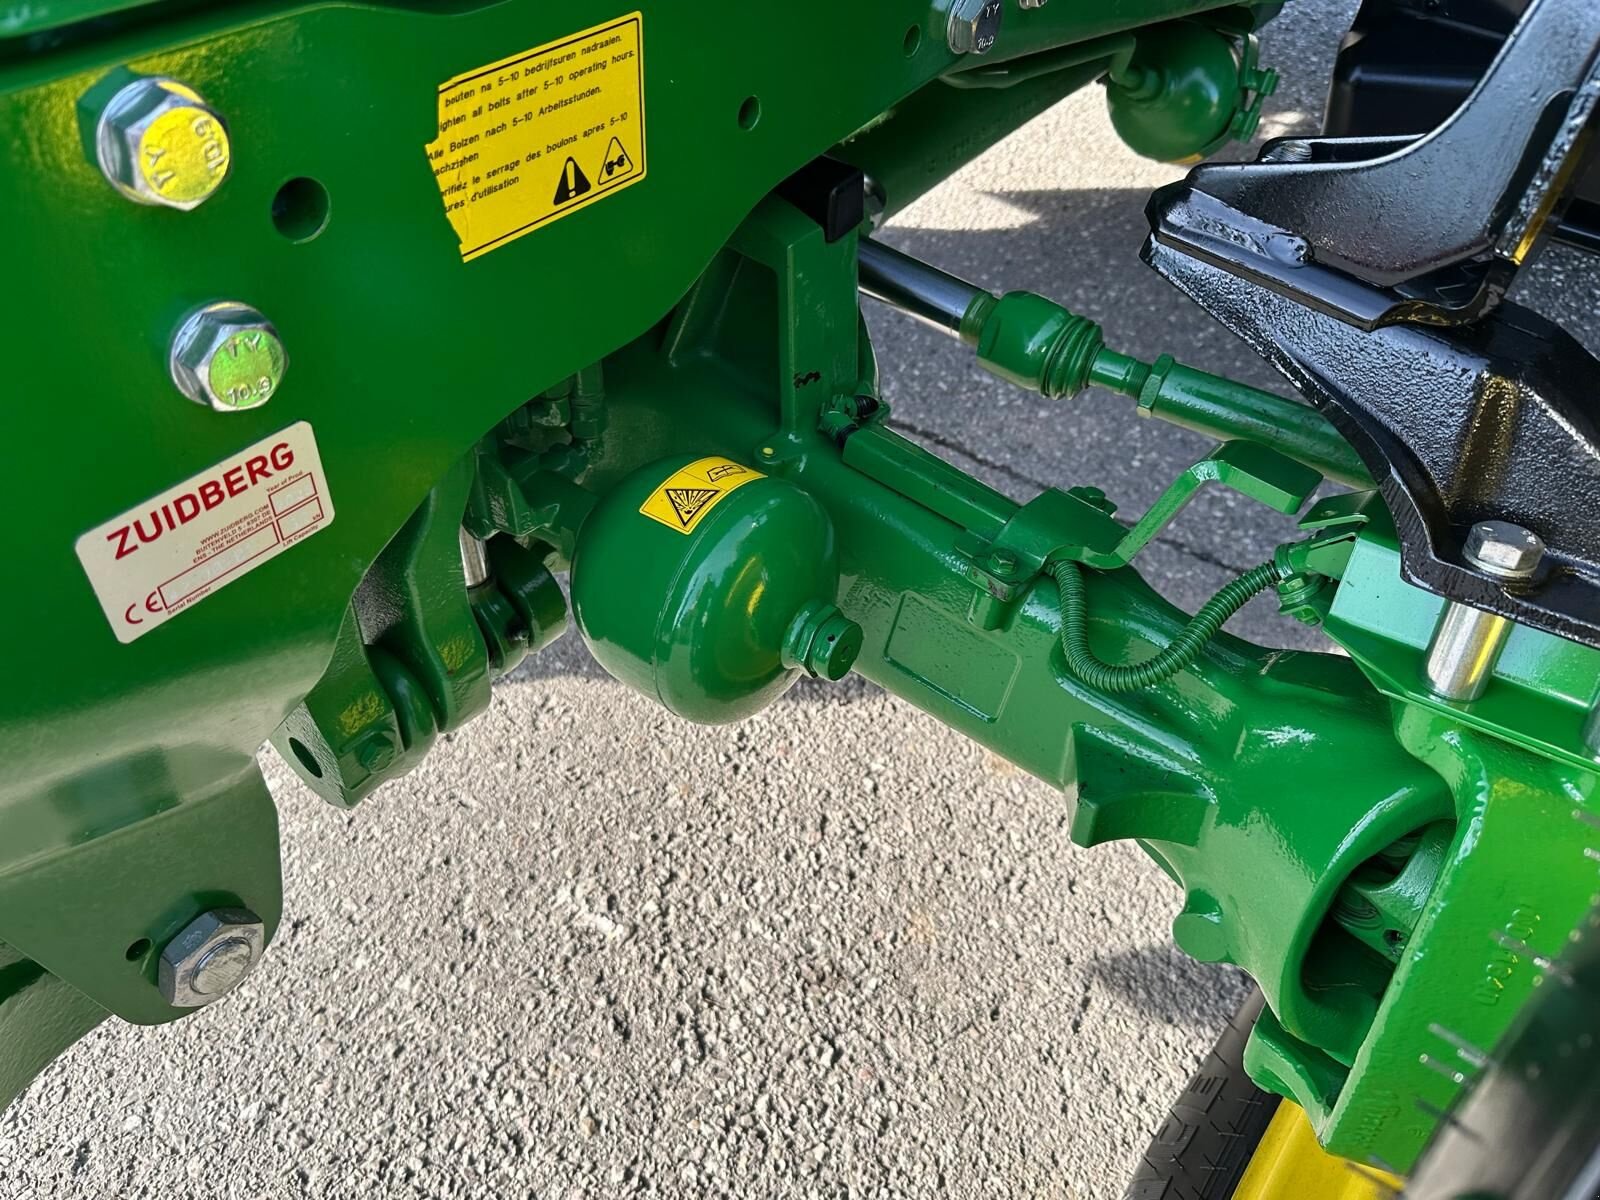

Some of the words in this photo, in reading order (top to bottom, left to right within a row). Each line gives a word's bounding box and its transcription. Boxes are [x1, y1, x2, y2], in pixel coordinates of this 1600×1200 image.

[445, 89, 475, 107] bouten
[481, 83, 492, 94] na
[498, 71, 519, 86] 5-10
[525, 51, 576, 77] bedrijfsuren
[581, 34, 622, 56] nadraaien.
[472, 108, 482, 118] all
[488, 96, 510, 111] bolts
[517, 87, 538, 101] after
[544, 75, 563, 90] 5-10
[569, 60, 607, 81] operating
[612, 50, 635, 63] hours.
[428, 149, 444, 161] Alle
[450, 135, 480, 152] Bolzen
[485, 123, 507, 137] nach
[512, 113, 532, 126] 5-10
[538, 86, 602, 116] Arbeitsstunden.
[473, 174, 480, 184] le
[486, 160, 520, 179] serrage
[526, 150, 541, 163] des
[547, 134, 577, 154] boulons
[583, 124, 605, 138] apres
[610, 112, 628, 126] 5-10
[471, 176, 519, 202] d'utilisation
[227, 376, 272, 406] 10.9
[107, 443, 294, 560] ZUIDBERG
[262, 510, 270, 518] DE
[193, 553, 207, 563] ENS
[212, 543, 225, 555] THE
[226, 516, 273, 546] NETHERLANDS
[167, 602, 185, 615] Serial
[187, 587, 211, 603] Number
